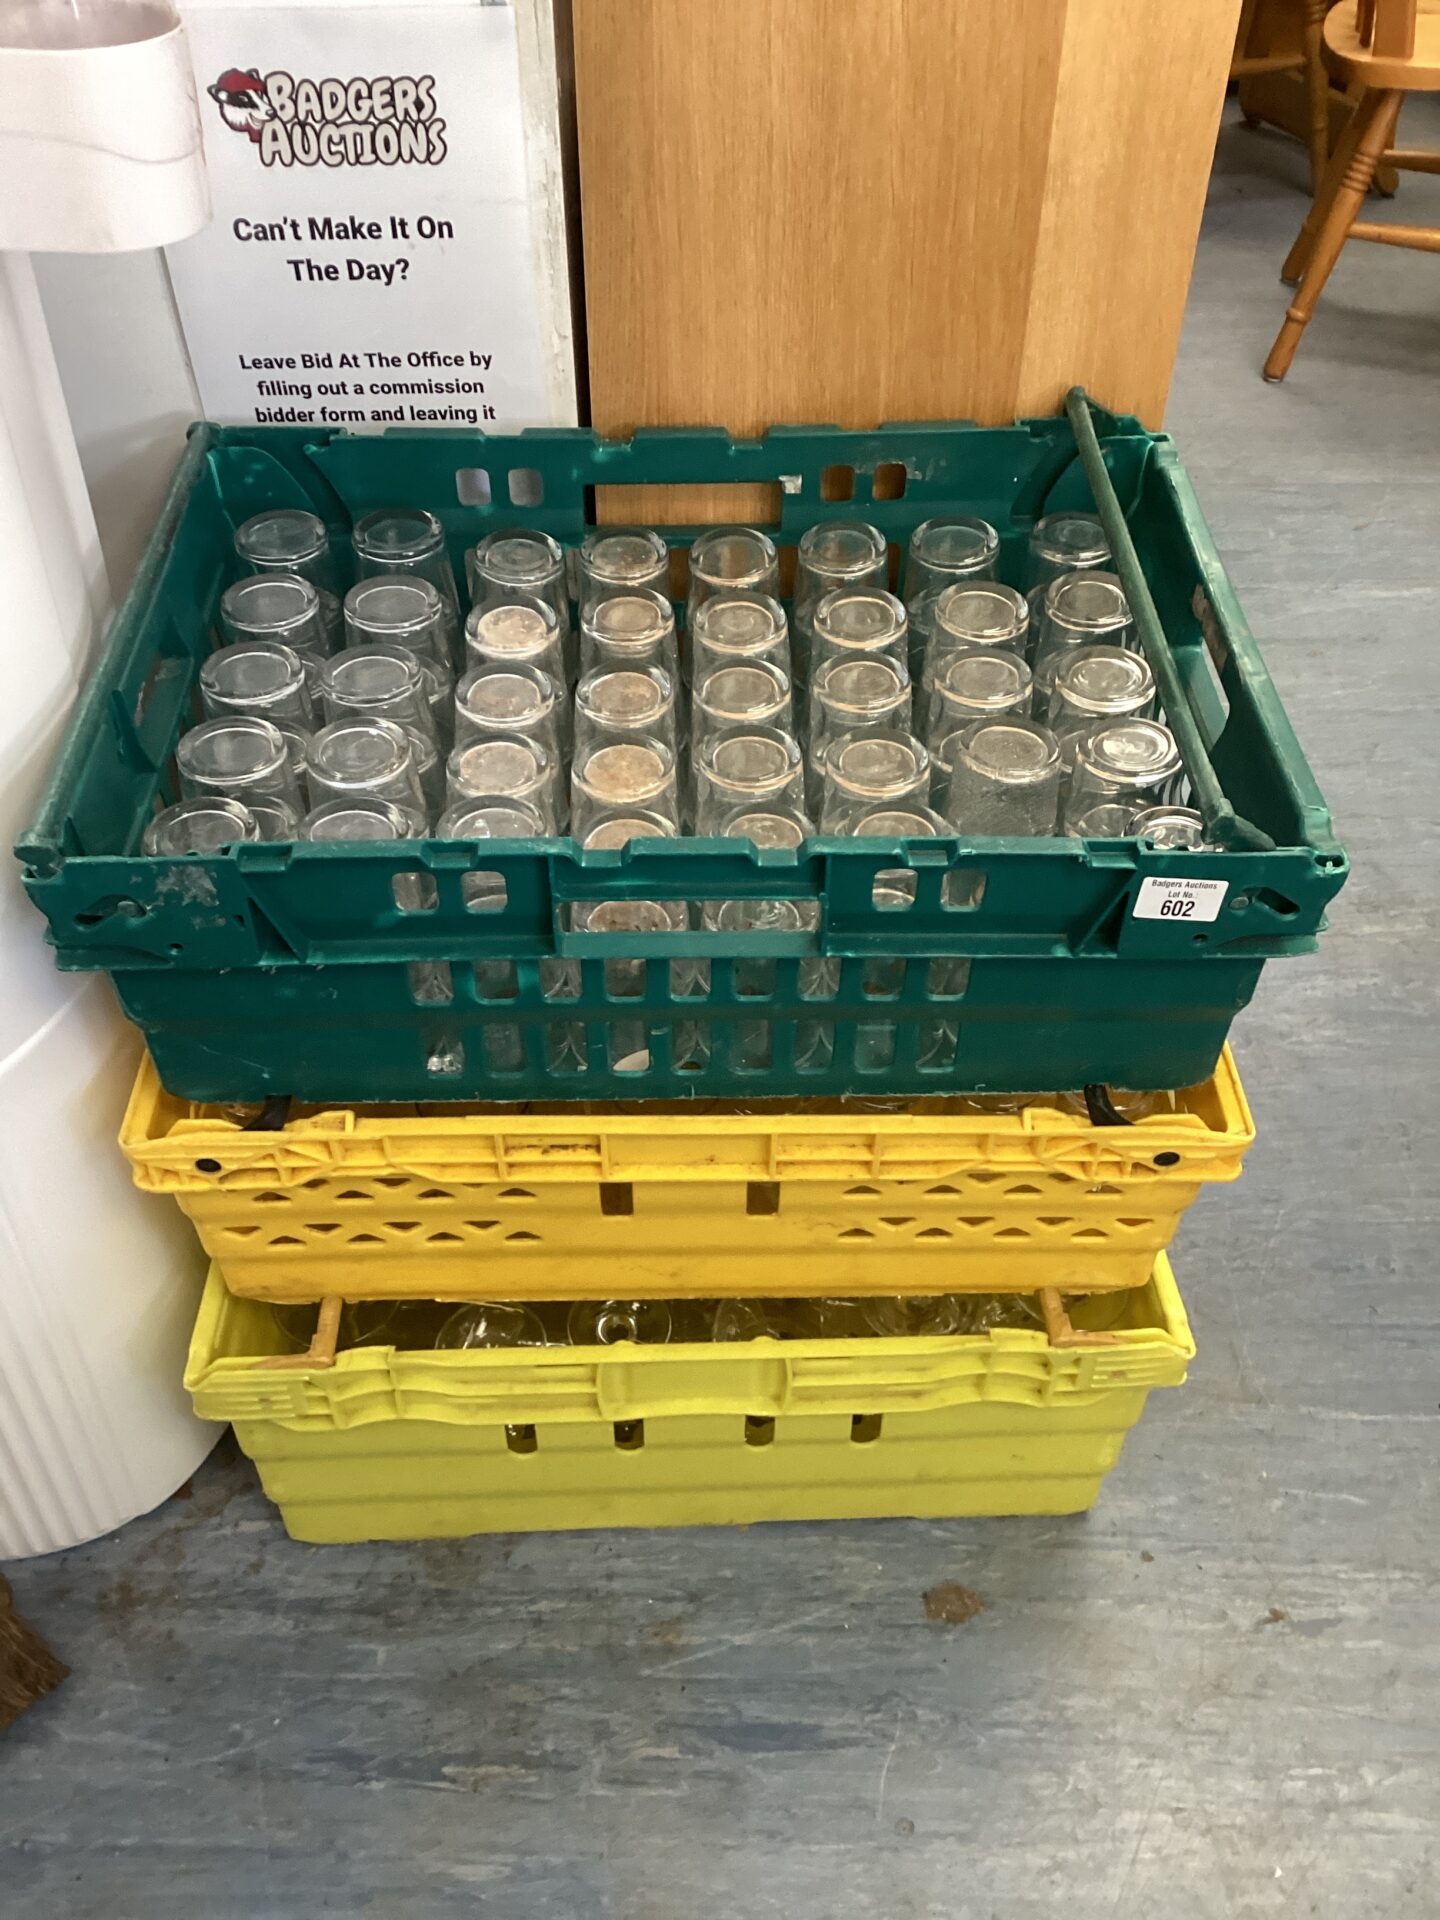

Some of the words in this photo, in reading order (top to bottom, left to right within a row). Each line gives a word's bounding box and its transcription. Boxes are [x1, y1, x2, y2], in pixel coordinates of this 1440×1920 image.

[263, 70, 437, 124] BADGERS
[258, 117, 448, 167] AUCTIONS
[232, 217, 302, 242] Can't
[308, 216, 382, 240] Make
[390, 216, 409, 239] It
[417, 216, 454, 239] On
[287, 259, 340, 282] The
[347, 257, 410, 286] Day?
[239, 354, 297, 370] Leave
[301, 354, 333, 369] Bid
[339, 353, 361, 369] At
[365, 352, 402, 368] The
[407, 351, 465, 367] Office
[470, 351, 493, 370] by
[257, 380, 313, 399] filling
[317, 380, 349, 396] out
[354, 383, 365, 395] a
[369, 379, 485, 395] commission
[255, 407, 315, 423] bidder
[320, 407, 366, 422] form
[370, 406, 405, 421] and
[410, 406, 478, 424] leaving
[483, 405, 497, 420] it
[1151, 879, 1182, 888] Badgers
[1184, 881, 1217, 889] Auctions
[1167, 890, 1181, 898] Lot
[1160, 900, 1195, 917] 602
